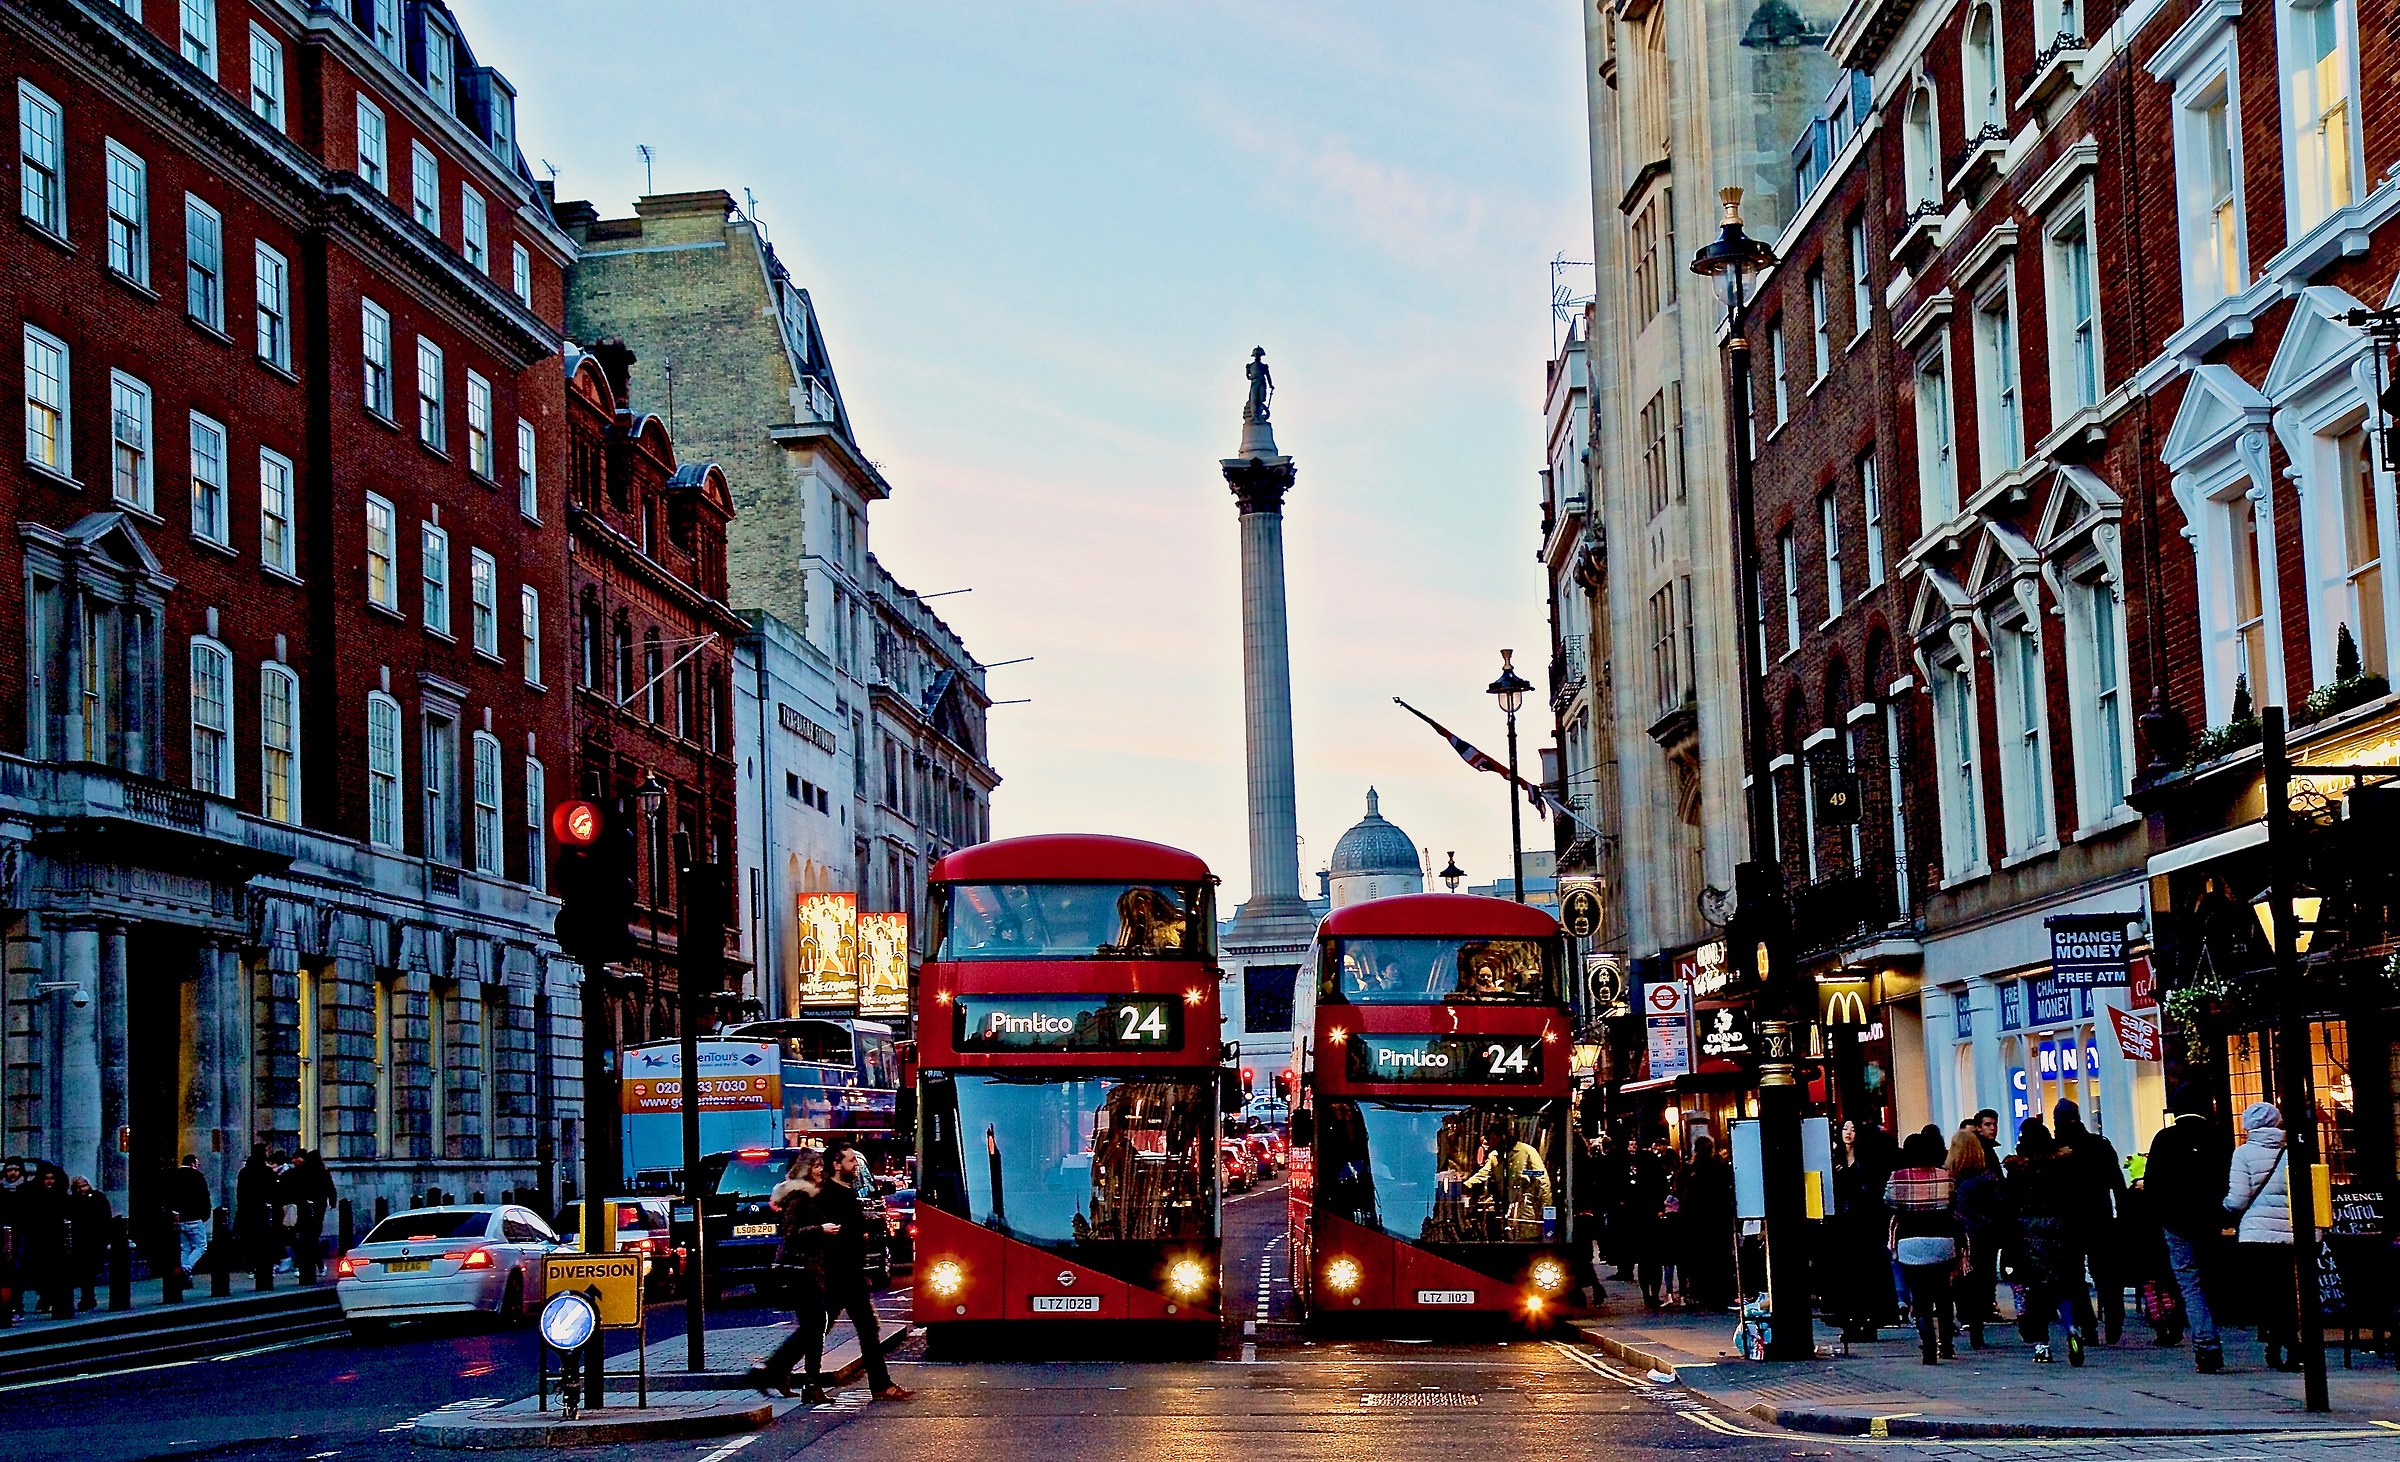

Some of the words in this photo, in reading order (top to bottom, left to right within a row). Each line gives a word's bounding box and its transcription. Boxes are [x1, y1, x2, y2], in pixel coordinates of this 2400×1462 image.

[1829, 792, 1847, 806] 49
[2055, 930, 2122, 944] CHANGE
[2056, 944, 2123, 959] MONEY
[2057, 972, 2093, 983] FREE
[2096, 971, 2126, 982] ATM
[2003, 986, 2019, 1004] FRE
[2005, 1004, 2020, 1025] AT
[2037, 995, 2070, 1020] MONEY
[991, 1011, 1073, 1034] Pimlico
[1119, 1005, 1167, 1040] 24
[2119, 1015, 2153, 1036] sale
[2120, 1028, 2154, 1050] sale
[671, 1052, 739, 1063] GenTours
[2121, 1041, 2153, 1061] sale
[1378, 1048, 1449, 1067] Pimlico
[1488, 1045, 1529, 1074] 24
[655, 1082, 681, 1094] 020
[715, 1080, 748, 1092] 7030
[640, 1094, 763, 1109] www.goentours.com
[736, 1225, 756, 1235] LS06
[549, 1263, 635, 1279] DIVERSION
[1039, 1298, 1064, 1310] LTZ
[1065, 1298, 1092, 1310] 1028
[1423, 1293, 1442, 1303] LTZ
[1448, 1293, 1468, 1303] 1103
